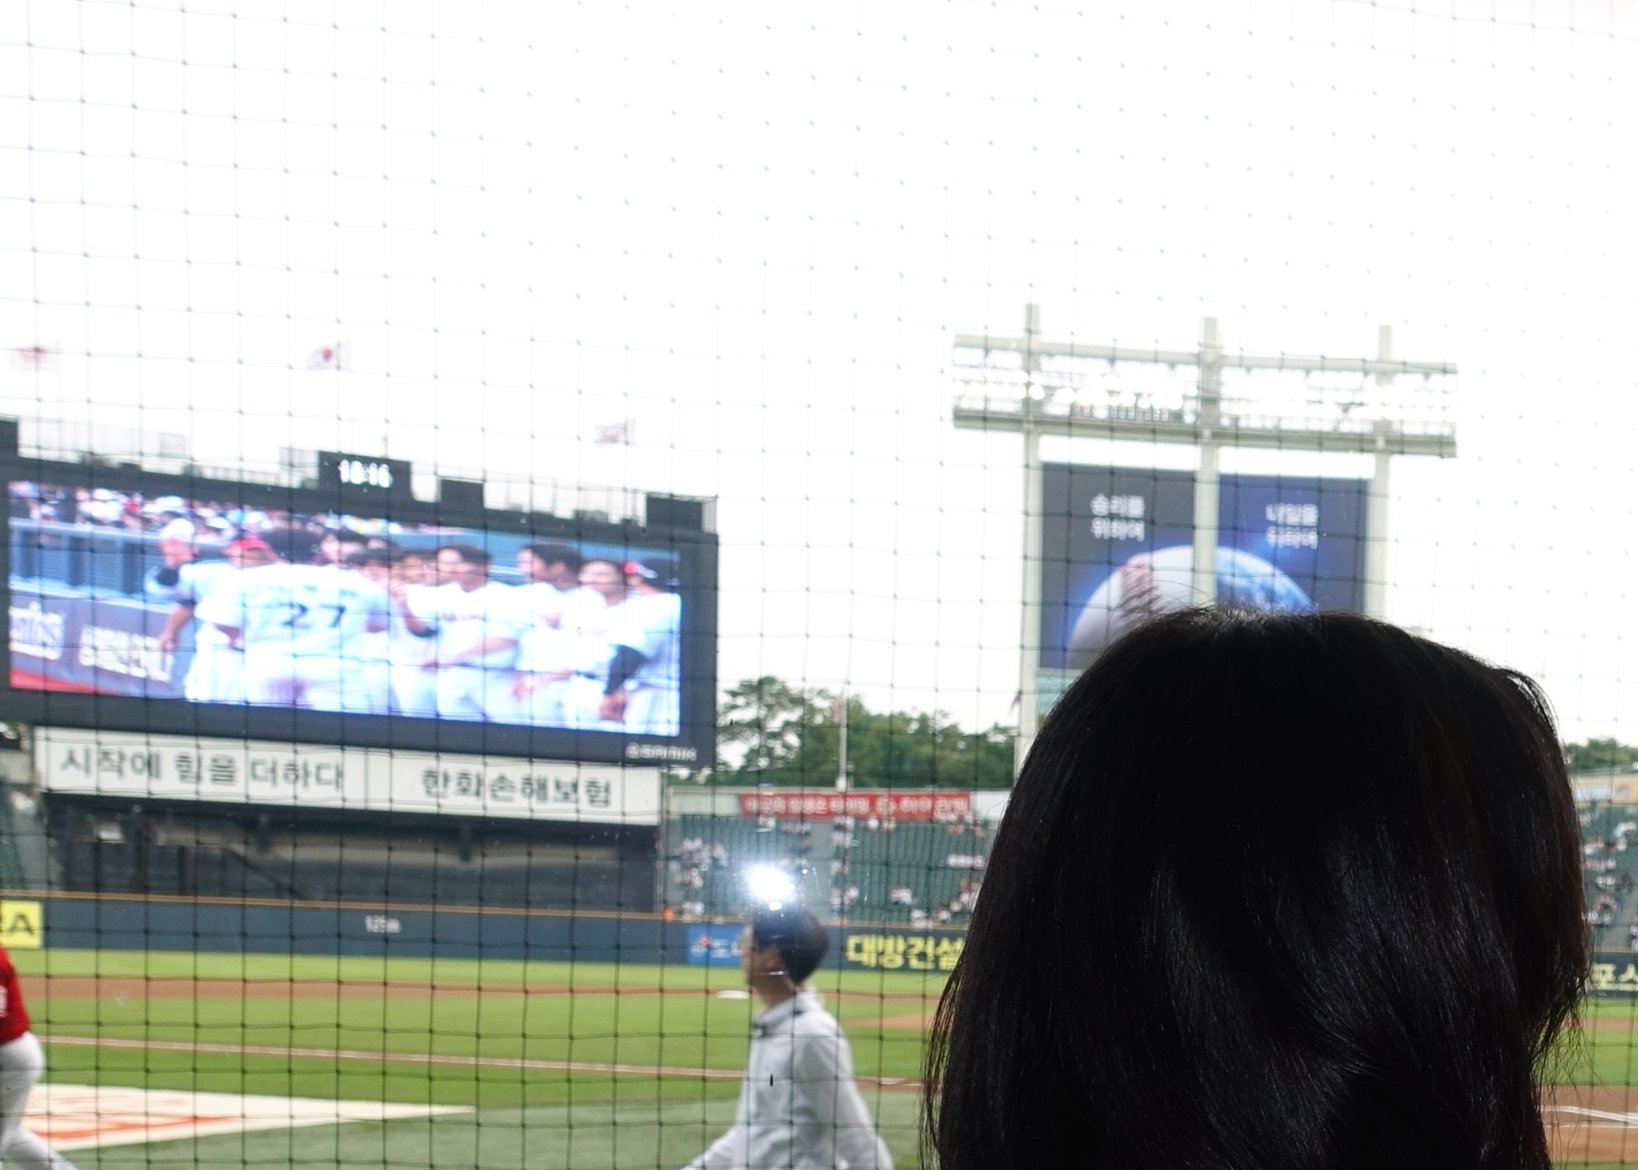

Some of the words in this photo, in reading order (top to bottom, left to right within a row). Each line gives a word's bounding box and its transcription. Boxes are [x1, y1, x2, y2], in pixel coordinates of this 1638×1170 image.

[1090, 517, 1145, 542] 위하여
[60, 747, 162, 780] 시작에
[174, 750, 238, 786] 힘을
[250, 757, 344, 791] 더하다
[421, 766, 611, 808] 한화손해보험
[0, 914, 34, 937] A
[846, 933, 963, 971] 대방건설
